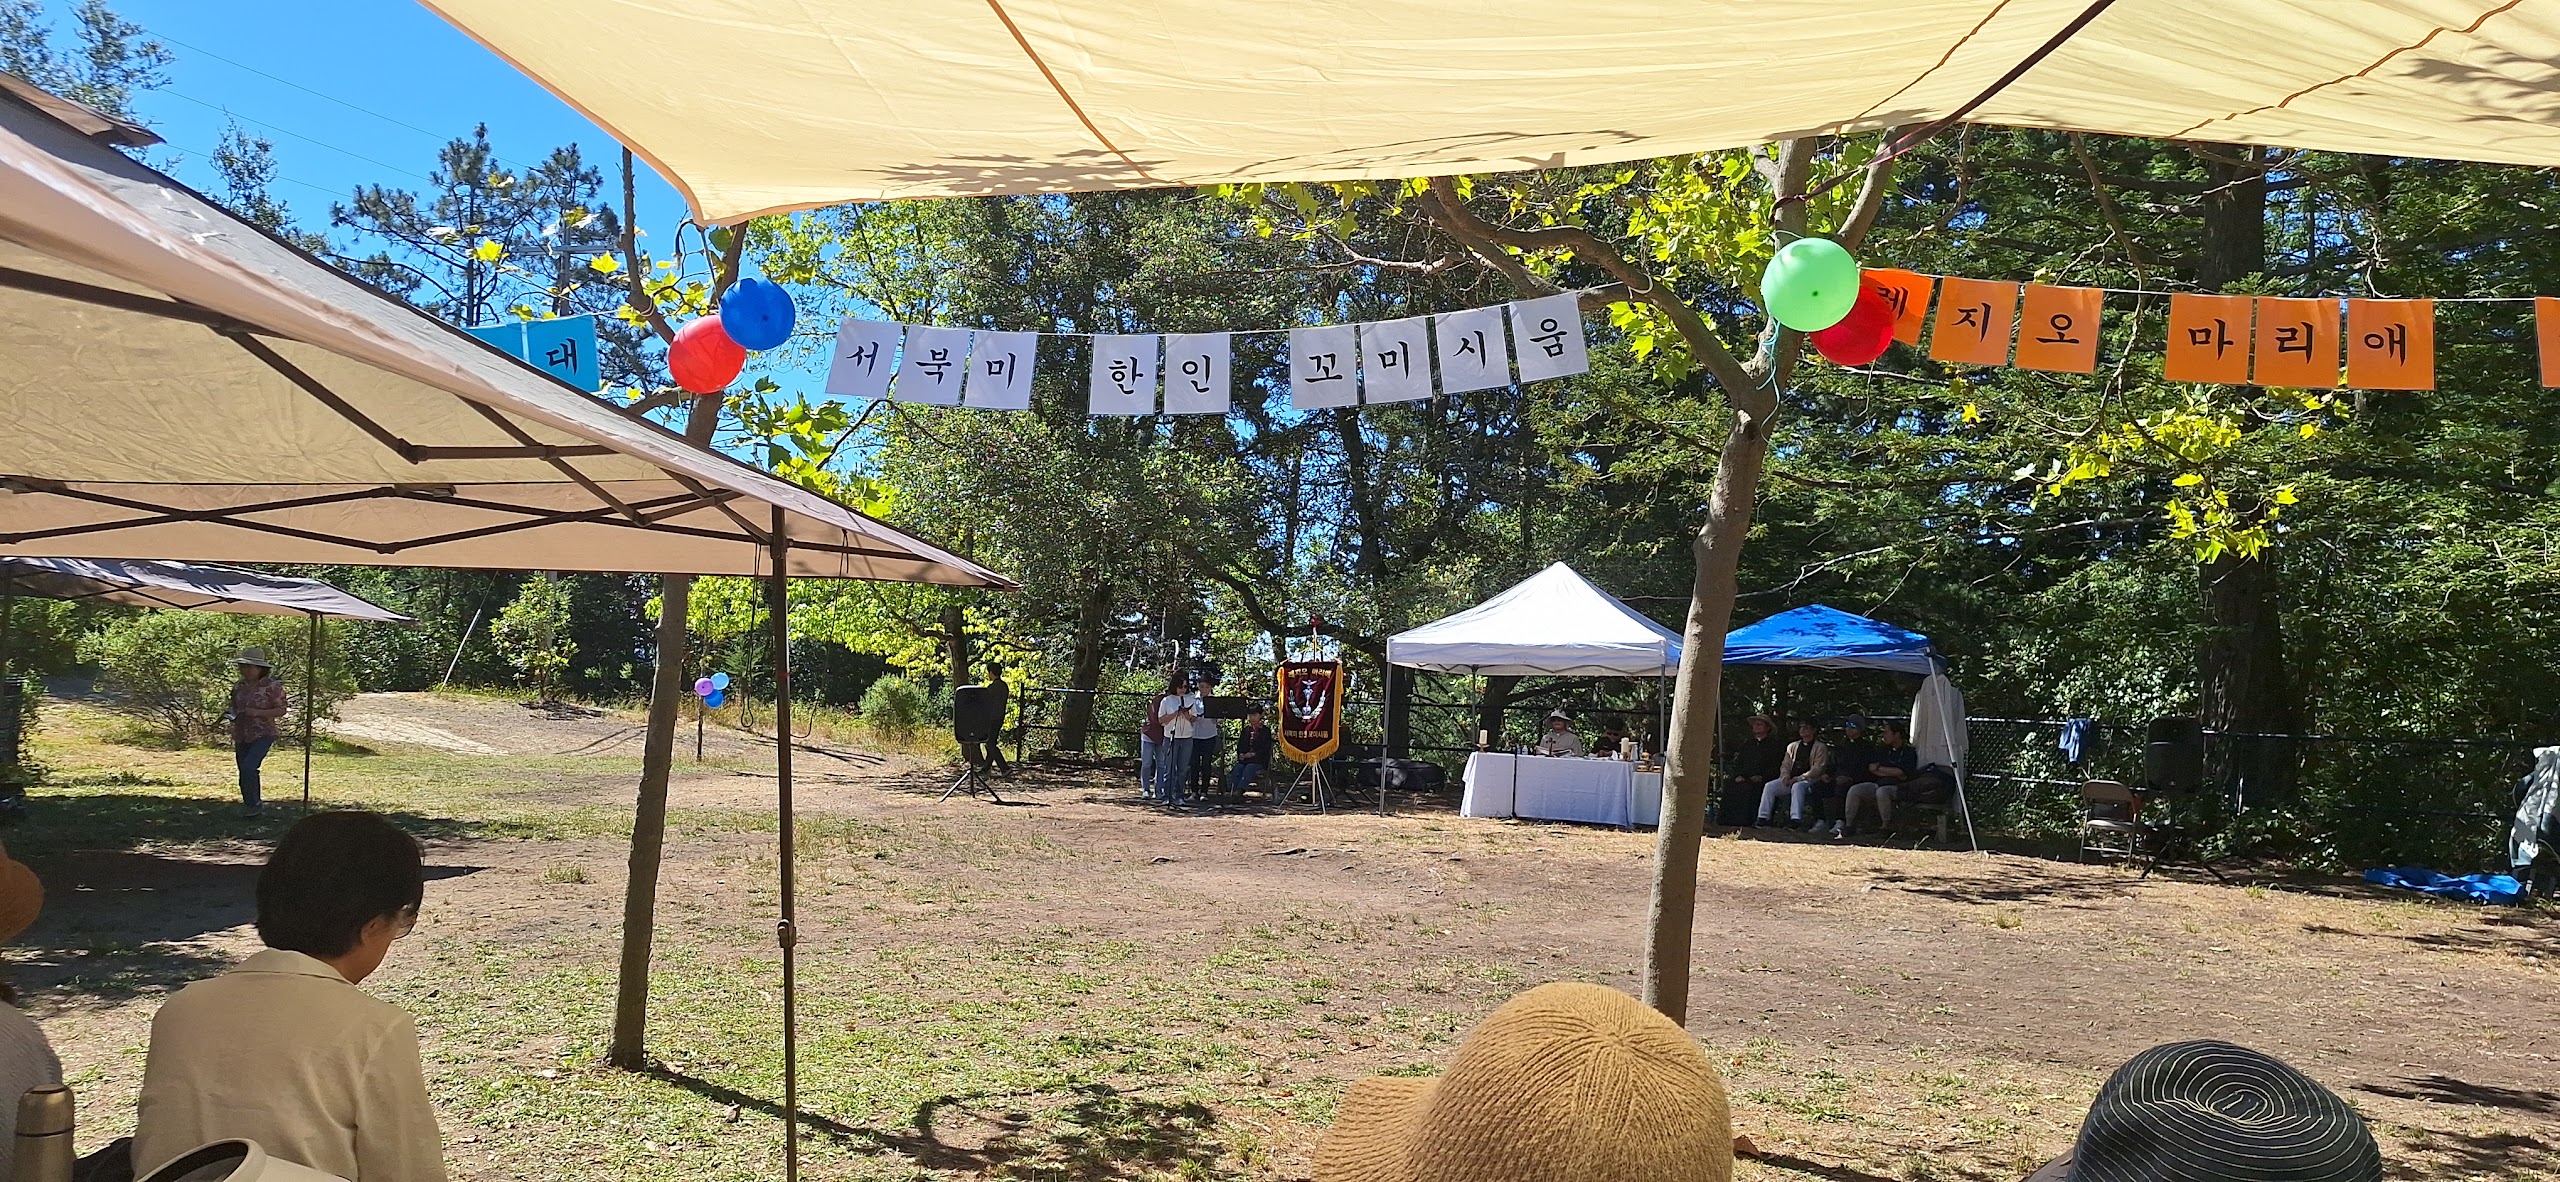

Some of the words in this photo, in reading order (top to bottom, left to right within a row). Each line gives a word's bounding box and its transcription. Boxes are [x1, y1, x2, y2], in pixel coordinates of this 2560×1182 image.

[546, 338, 578, 375] 대
[847, 341, 1017, 390] 서북미
[1108, 354, 1212, 396] 한인
[1305, 317, 1569, 384] 꼬미시움
[2188, 318, 2407, 368] 마리애
